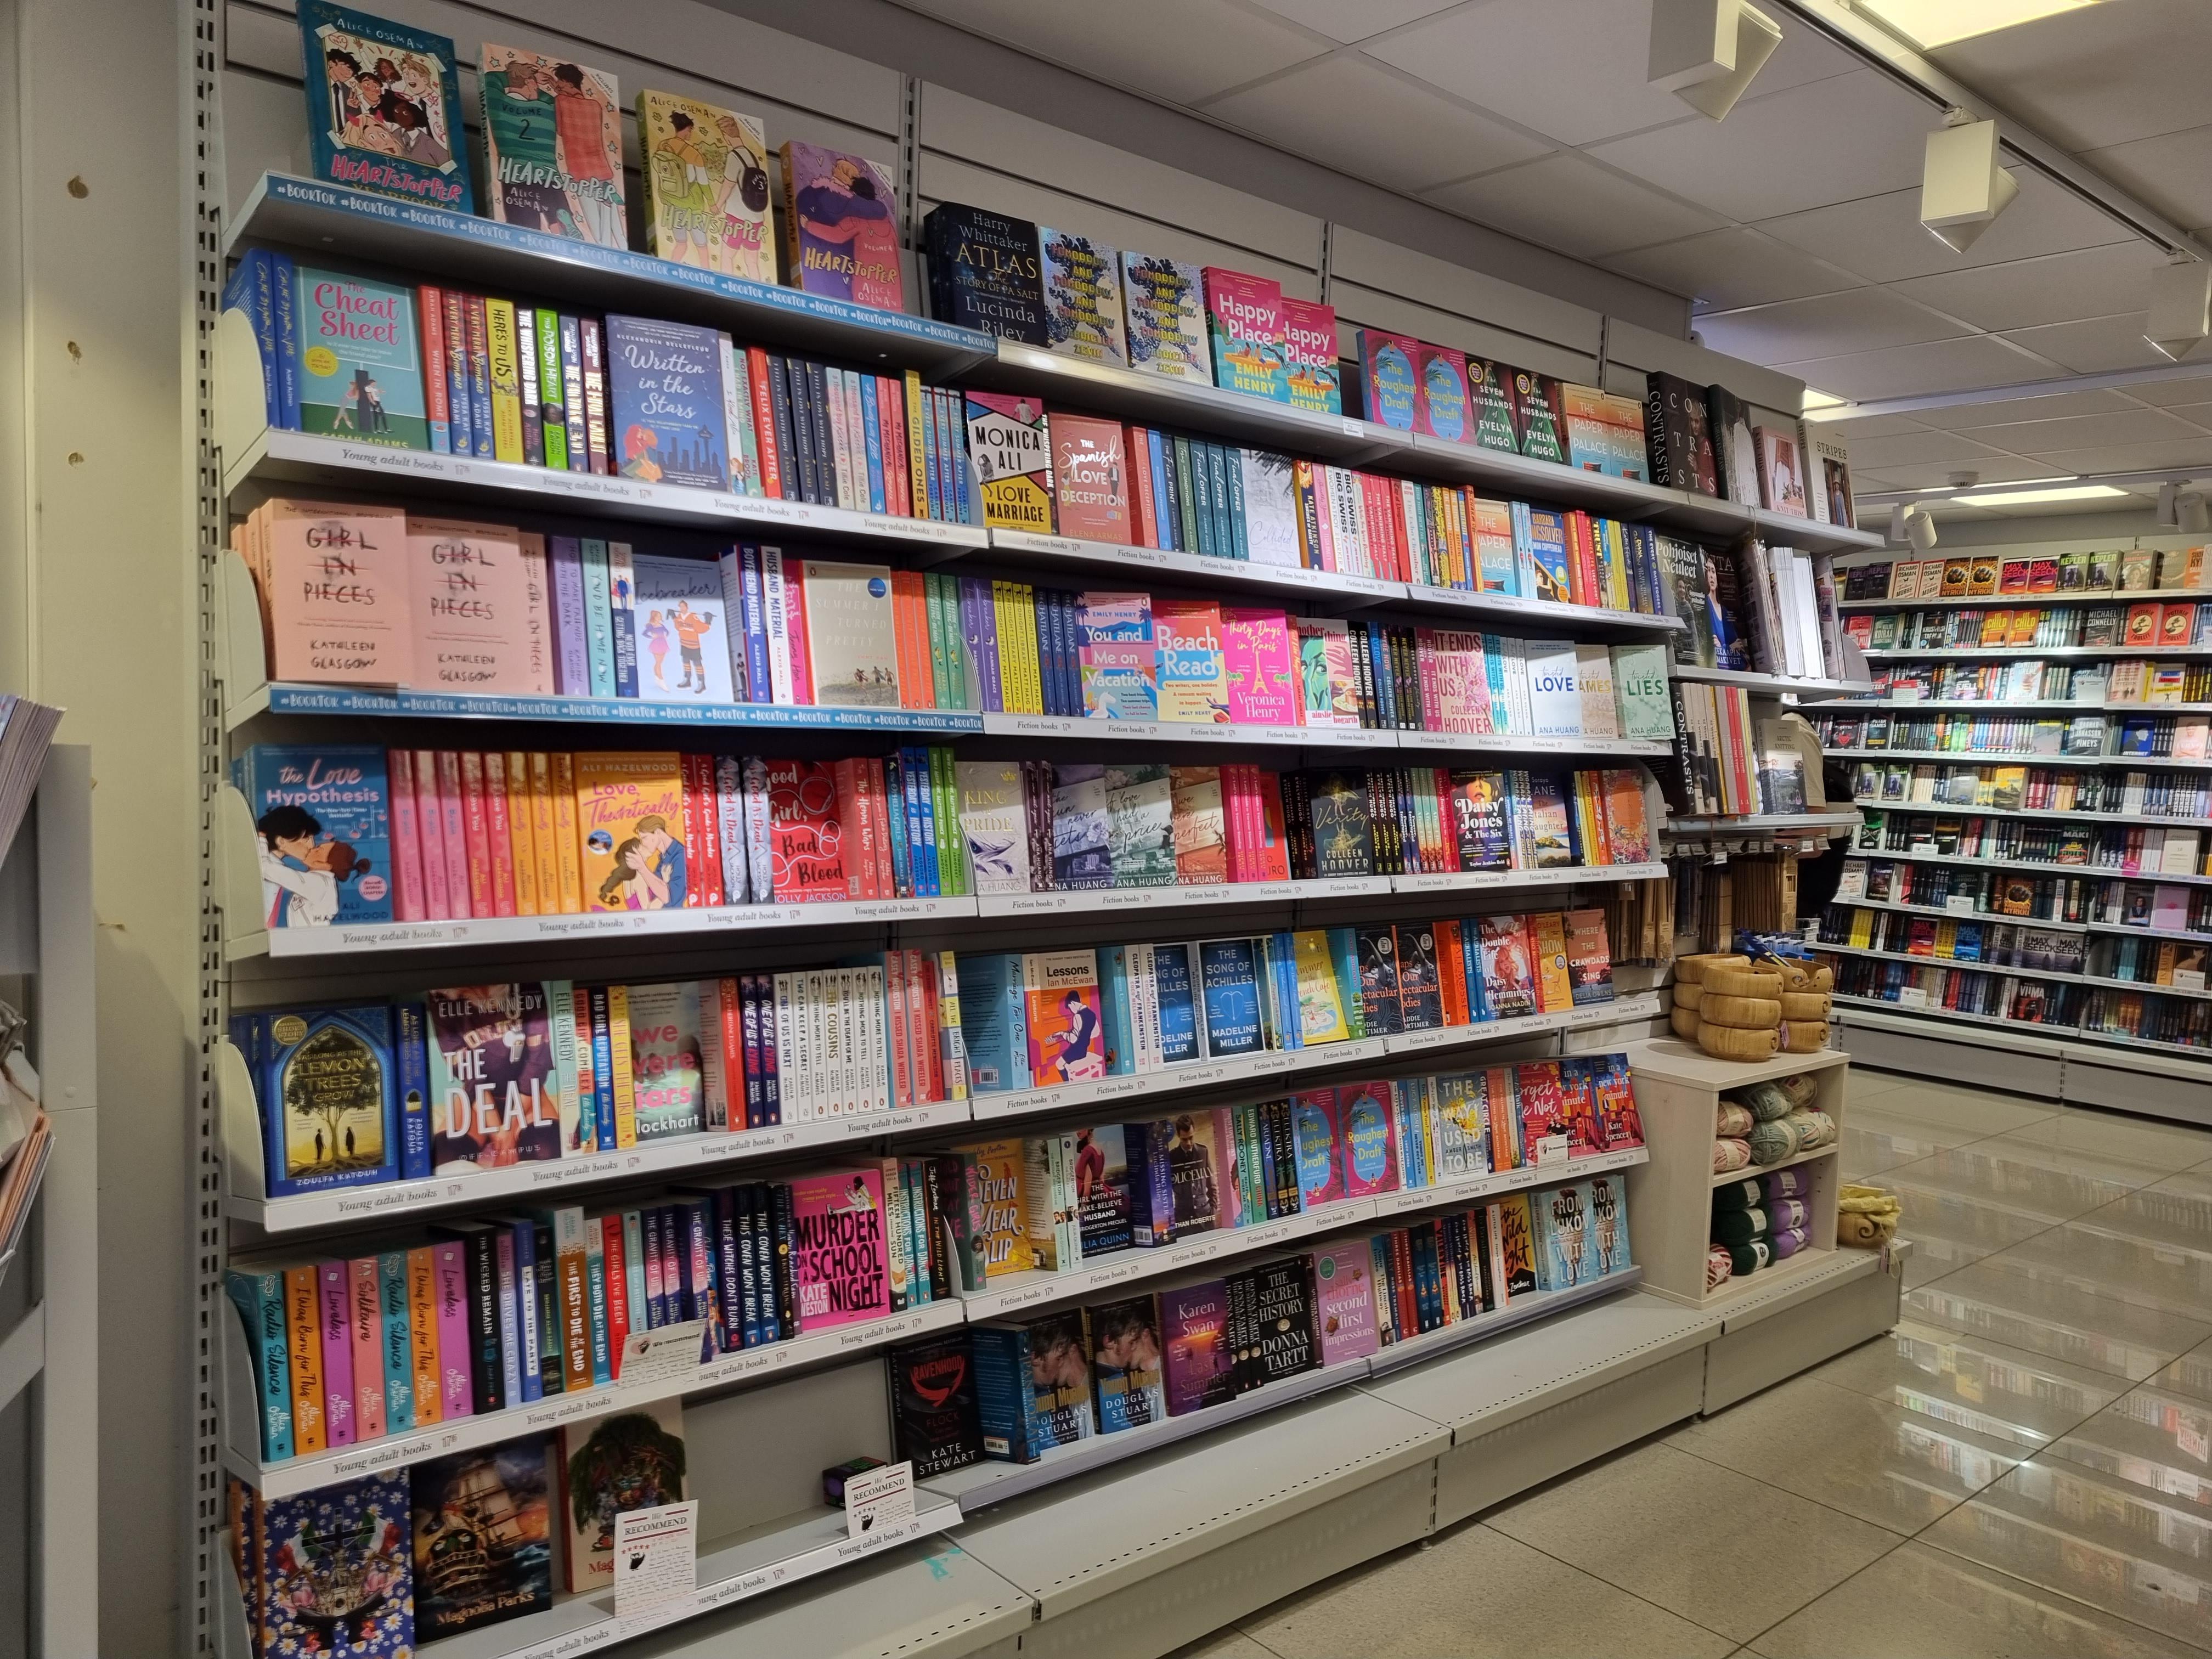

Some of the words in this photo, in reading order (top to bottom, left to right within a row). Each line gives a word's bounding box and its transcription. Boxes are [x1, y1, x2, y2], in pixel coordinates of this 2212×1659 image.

[331, 154, 463, 202] HEARTSTOPPER
[973, 212, 1010, 233] Harry
[960, 225, 1027, 252] Whittaker
[804, 247, 896, 284] HEARTSTOPPER
[955, 242, 1036, 280] ATLAS
[345, 281, 365, 294] The
[314, 283, 399, 320] Cheat
[964, 295, 1036, 324] Lucinda
[1219, 294, 1276, 327] Happy
[320, 311, 399, 346] Sheet
[981, 319, 1025, 342] Riley
[1228, 321, 1273, 345] Place
[626, 345, 705, 374] Written
[1235, 362, 1272, 380] EMILY
[639, 375, 658, 388] in
[663, 377, 692, 395] the
[1233, 376, 1276, 394] HENRY
[1374, 376, 1417, 394] Roughest
[1480, 385, 1504, 398] SEVEN
[641, 393, 696, 419] Stars
[759, 385, 769, 413] FELIX
[1385, 394, 1409, 409] Draft
[1472, 395, 1513, 410] HUSBANDS
[1579, 402, 1594, 414] THE
[763, 416, 772, 444] EVER
[1479, 420, 1512, 433] EVELYN
[1575, 418, 1603, 434] PAPER
[912, 417, 922, 463] GILDED
[975, 425, 1040, 450] MONICA
[1080, 439, 1094, 449] THE
[1485, 435, 1510, 447] HUGO
[1573, 437, 1607, 454] PALACE
[1649, 391, 1669, 483] CONTRASTS
[998, 448, 1022, 471] ALI
[1058, 436, 1121, 469] Spanish
[1816, 442, 1847, 460] STRIPES
[767, 447, 777, 480] AFTER
[916, 468, 924, 503] ONES
[1074, 470, 1107, 486] LOVE
[997, 485, 1031, 504] LOVE
[1060, 489, 1125, 507] DECEPTION
[986, 500, 1043, 522] MARRIAGE
[1347, 497, 1356, 534] SWISS
[306, 527, 377, 550] GIRL
[1118, 549, 1138, 559] Fiction
[1140, 552, 1154, 561] books
[1657, 542, 1697, 564] Pohjoiset
[2090, 553, 2117, 564] KEPLER
[766, 551, 778, 593] HUSBAND
[1662, 557, 1696, 578] Neuleet
[304, 582, 375, 605] PIECES
[770, 597, 782, 640] MATERIAL
[1113, 610, 1136, 618] HENRY
[2015, 618, 2036, 628] CHILD
[2087, 617, 2117, 627] CONNELLY
[1086, 628, 1111, 643] You
[1116, 628, 1142, 641] and
[1158, 625, 1218, 651] Beach
[1434, 632, 1445, 651] IT
[1448, 633, 1481, 653] ENDS
[1094, 652, 1116, 665] Me
[1121, 655, 1138, 664] on
[1165, 652, 1216, 676] Read
[1436, 655, 1469, 676] WITH
[1086, 669, 1150, 687] Vacation
[1440, 678, 1455, 697] US
[1536, 677, 1574, 692] LOVE
[1627, 679, 1663, 696] LIES
[1237, 692, 1285, 708] Veronica
[1246, 704, 1280, 720] Henry
[1451, 705, 1480, 715] COLLEEN
[1444, 718, 1492, 734] HOOVER
[279, 769, 304, 785] the
[306, 759, 362, 791] Love
[266, 789, 379, 806] Hypothesis
[1454, 795, 1503, 814] Daisy
[1316, 808, 1369, 829] Verity
[1462, 812, 1503, 829] Jones
[1465, 829, 1472, 839] &
[1475, 829, 1489, 838] The
[1491, 829, 1503, 838] Six
[782, 836, 818, 857] Bad
[799, 867, 844, 885] Blood
[805, 891, 846, 902] JACKSON
[1575, 926, 1598, 936] WHERE
[1481, 936, 1510, 949] Double
[1582, 941, 1595, 951] THE
[1218, 950, 1238, 959] THE
[1570, 956, 1609, 967] CRAWDADS
[1047, 965, 1089, 977] Lessons
[1207, 964, 1234, 974] SONG
[1237, 962, 1250, 972] OF
[1582, 970, 1600, 981] SING
[1062, 977, 1094, 986] McEwan
[1206, 974, 1253, 988] ACHILLES
[1488, 988, 1531, 1000] Hemmings
[439, 1001, 474, 1017] ELLE
[478, 994, 543, 1017] KENNEDY
[1488, 1001, 1510, 1010] JOANNA
[1513, 1000, 1531, 1008] NADIN
[828, 1013, 839, 1059] COUSINS
[1212, 1024, 1257, 1038] MADELINE
[1220, 1036, 1253, 1048] MILLER
[445, 1049, 486, 1081] THE
[1442, 1080, 1473, 1097] THE
[445, 1077, 552, 1139] DEAL
[1007, 1098, 1027, 1108] Fiction
[1029, 1096, 1047, 1106] books
[636, 1114, 699, 1133] lockhart
[1248, 1109, 1256, 1137] EDWARD
[1608, 1121, 1623, 1132] Kate
[1444, 1130, 1481, 1146] USED
[1605, 1130, 1629, 1142] Spencer
[1238, 1138, 1246, 1173] ROONEY
[1250, 1139, 1261, 1184] RUTHERFURD
[1553, 1195, 1585, 1213] FROM
[740, 1214, 751, 1235] THIS
[795, 1209, 880, 1252] MURDER
[1550, 1215, 1589, 1234] LUKOV
[724, 1244, 735, 1274] WITCHES
[741, 1239, 753, 1265] COVEN
[810, 1242, 882, 1282] SCHOOL
[742, 1268, 755, 1295] WON'T
[1268, 1272, 1288, 1287] THE
[725, 1277, 737, 1303] DON'T
[799, 1283, 827, 1302] KATE
[828, 1273, 883, 1312] NIGHT
[1260, 1284, 1300, 1305] SECRET
[744, 1298, 756, 1322] BREAK
[801, 1299, 828, 1317] WESTON
[1178, 1301, 1215, 1320] Karen
[1259, 1300, 1303, 1322] HISTORY
[1327, 1292, 1367, 1312] second
[727, 1306, 739, 1329] BURN
[1183, 1318, 1214, 1336] Swan
[1339, 1312, 1363, 1332] first
[840, 1336, 862, 1345] Young
[865, 1328, 883, 1339] adult
[885, 1323, 905, 1333] books
[1262, 1332, 1309, 1355] DONNA
[1325, 1327, 1374, 1346] impressions
[1265, 1347, 1308, 1372] TARTT
[932, 1443, 961, 1458] KATE
[919, 1451, 975, 1474] STEWART
[853, 1477, 905, 1501] RECOMMEND
[624, 1516, 687, 1535] RECOMMEND
[838, 1545, 861, 1557] Young
[864, 1537, 881, 1550] adult
[884, 1530, 904, 1543] books
